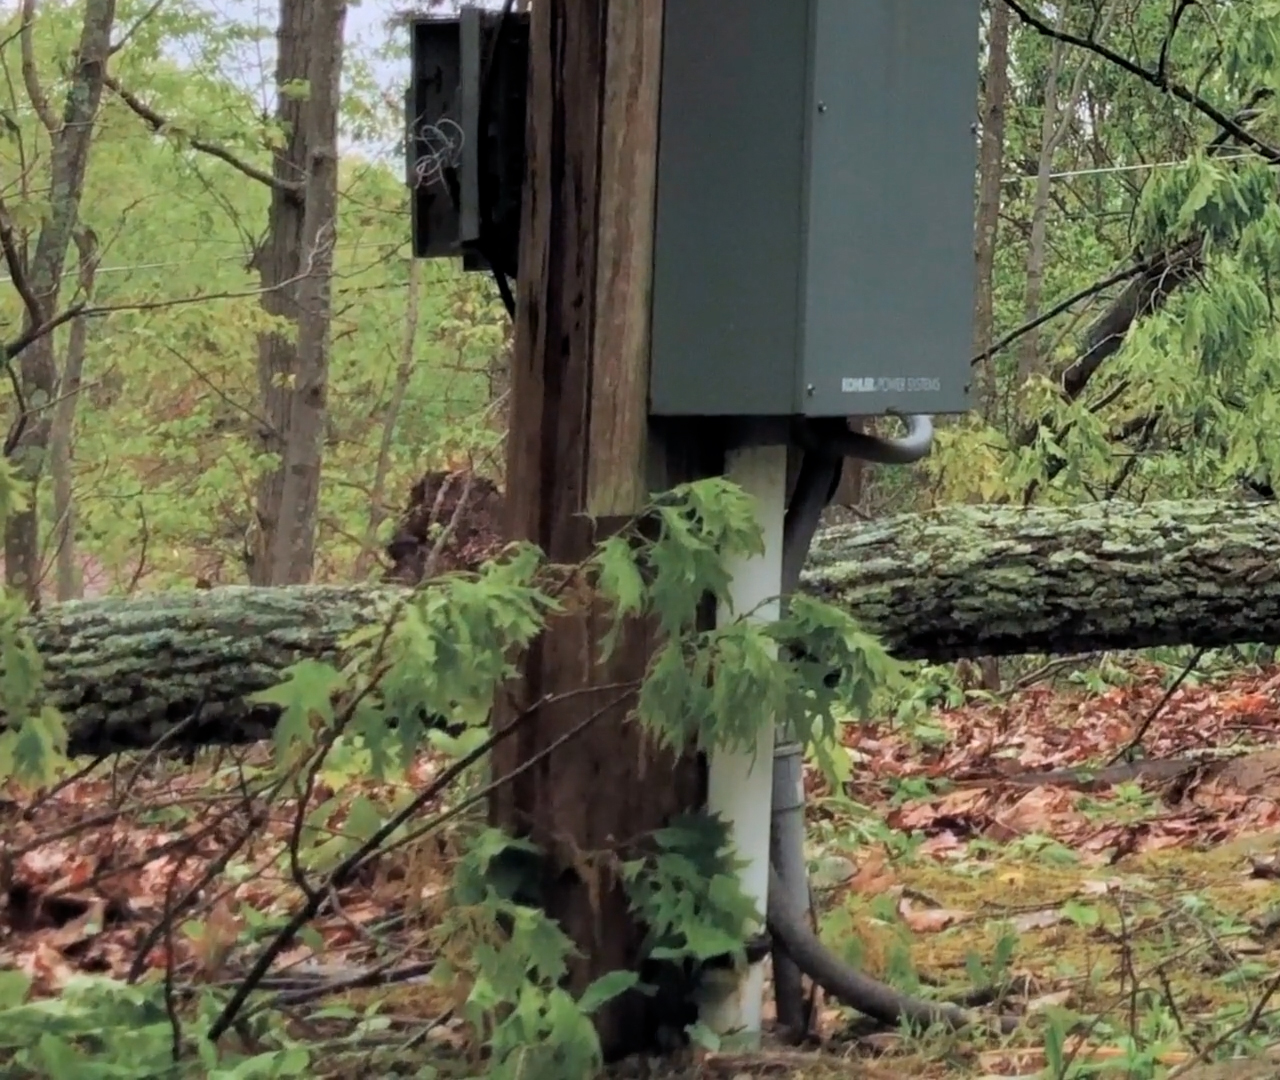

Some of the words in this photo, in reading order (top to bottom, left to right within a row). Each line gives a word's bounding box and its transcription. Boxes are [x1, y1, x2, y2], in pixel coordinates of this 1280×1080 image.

[841, 377, 877, 392] KOHLER
[878, 377, 905, 392] POWER
[907, 377, 941, 392] SYSTEMS
